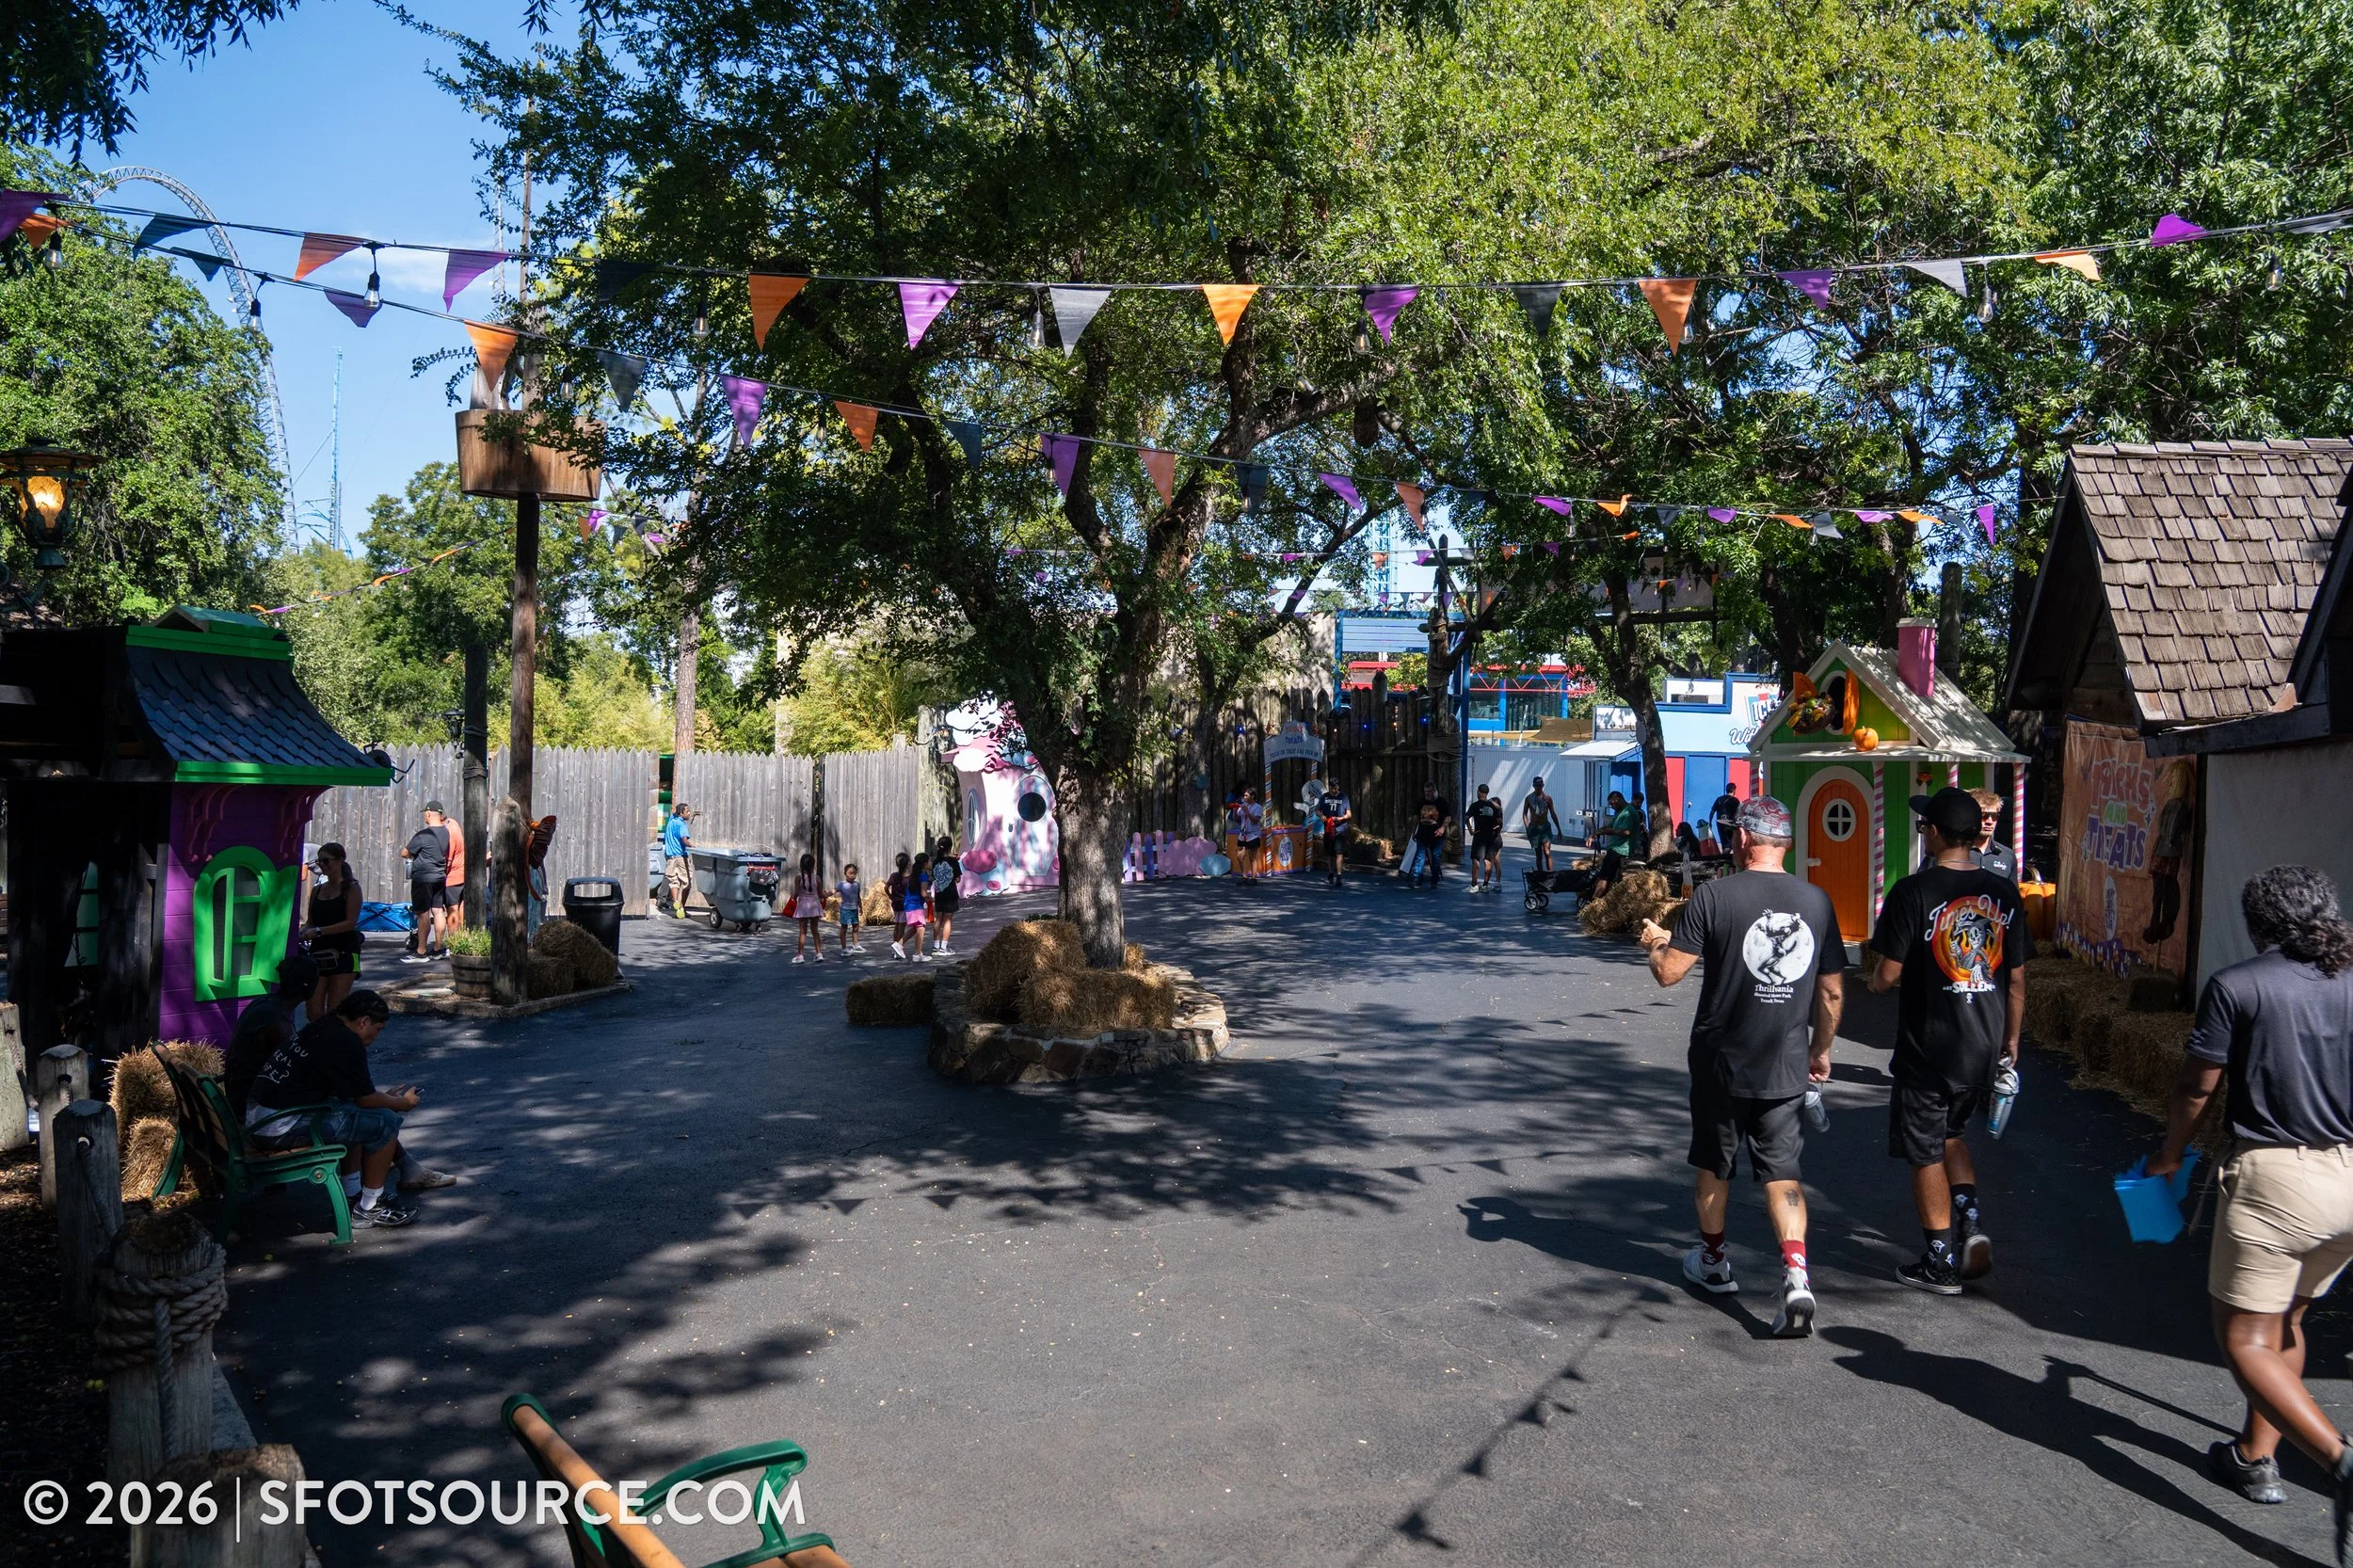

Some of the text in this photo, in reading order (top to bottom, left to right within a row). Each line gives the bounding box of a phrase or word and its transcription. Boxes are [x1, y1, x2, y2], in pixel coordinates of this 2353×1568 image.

[1977, 894, 2014, 934] Up!
[1754, 984, 1794, 993] Thrillvania
[1952, 981, 1993, 994] SULLEN
[289, 1042, 309, 1057] YOU
